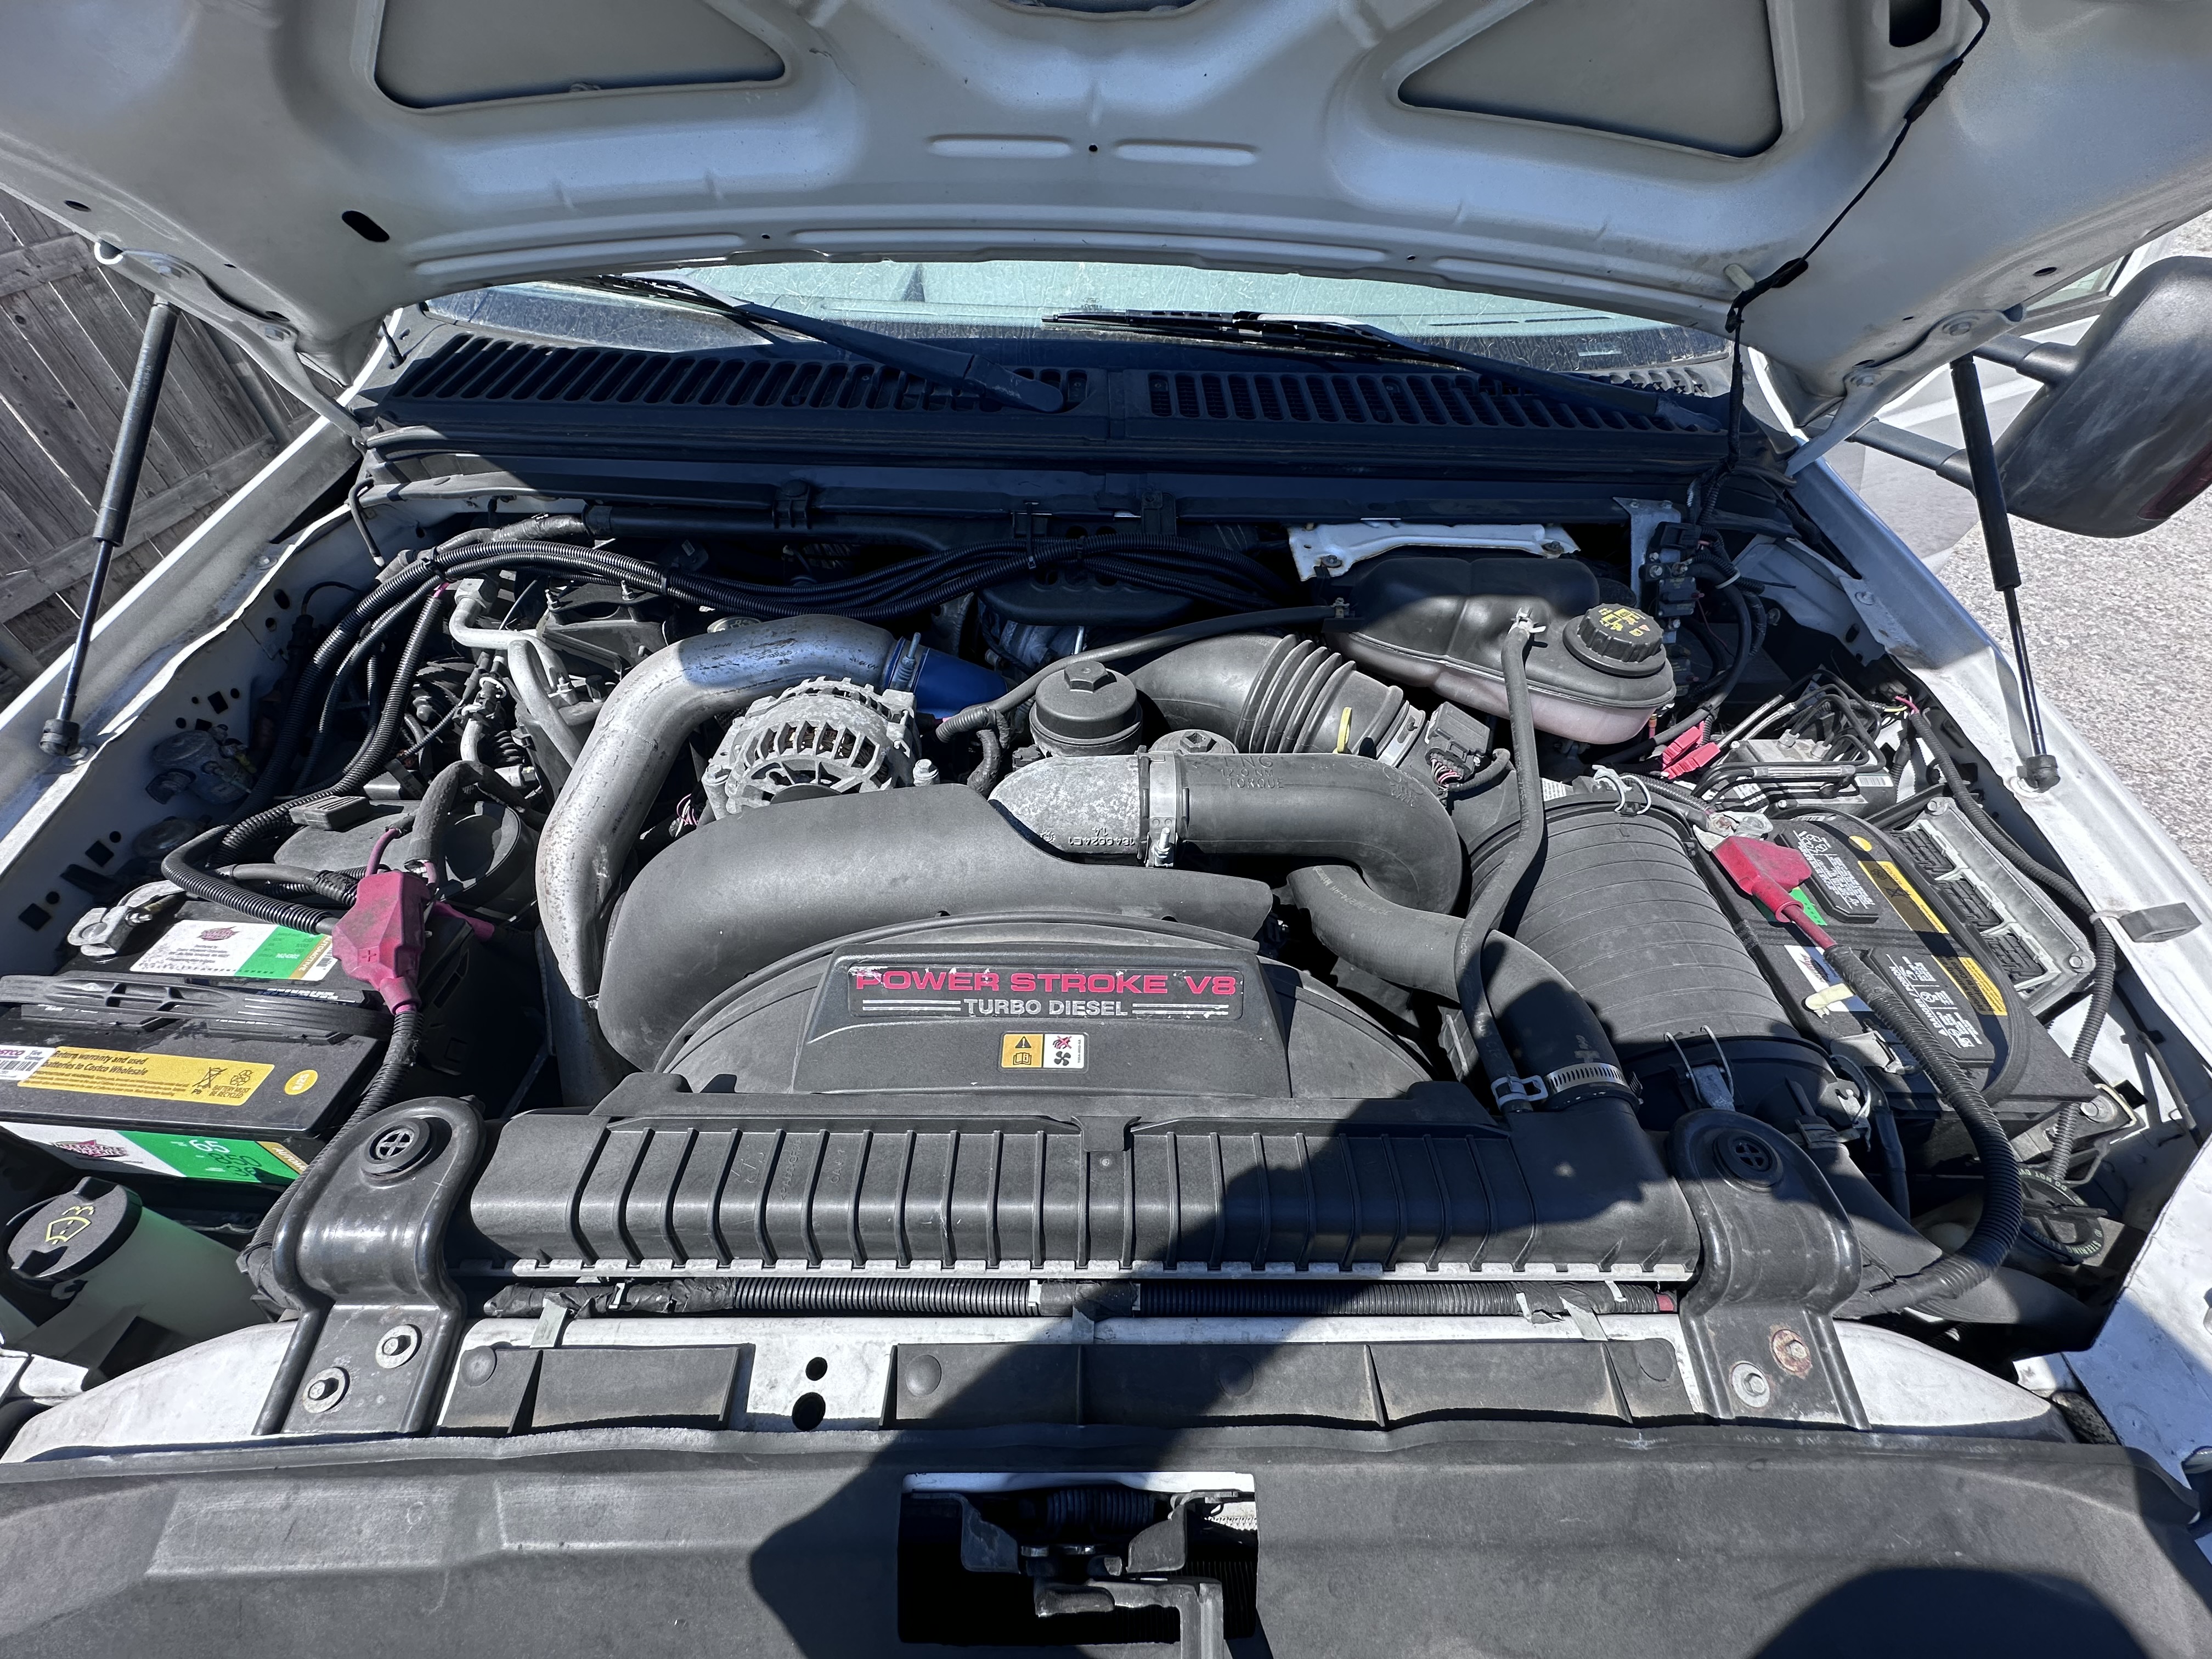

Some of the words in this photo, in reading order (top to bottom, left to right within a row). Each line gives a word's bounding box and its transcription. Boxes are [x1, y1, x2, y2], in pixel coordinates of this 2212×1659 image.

[1223, 755, 1274, 768] ENG
[1220, 768, 1250, 777] 12.0
[1254, 769, 1274, 777] NM
[1226, 777, 1285, 789] TORQUE
[856, 971, 1001, 992] POWER
[1011, 973, 1169, 995] STROKE
[1185, 976, 1237, 996] V8
[1888, 966, 1914, 991] POISON
[963, 998, 1042, 1015] TURBO
[1048, 999, 1128, 1017] DIESEL
[1914, 997, 1942, 1028] DANGER
[52, 1050, 78, 1059] Return
[78, 1052, 111, 1064] warranty
[111, 1056, 127, 1064] and
[127, 1057, 149, 1065] used
[42, 1061, 75, 1069] batteries
[84, 1063, 109, 1072] Costco
[110, 1065, 149, 1076] Wholesale
[188, 1139, 230, 1153] 65
[208, 1152, 262, 1167] 850
[272, 1147, 307, 1172] AUTOMO
[2035, 1171, 2052, 1183] NOT
[2055, 1181, 2068, 1192] DO
[2033, 1230, 2062, 1250] FLUID
[2066, 1240, 2102, 1255] STEERING
